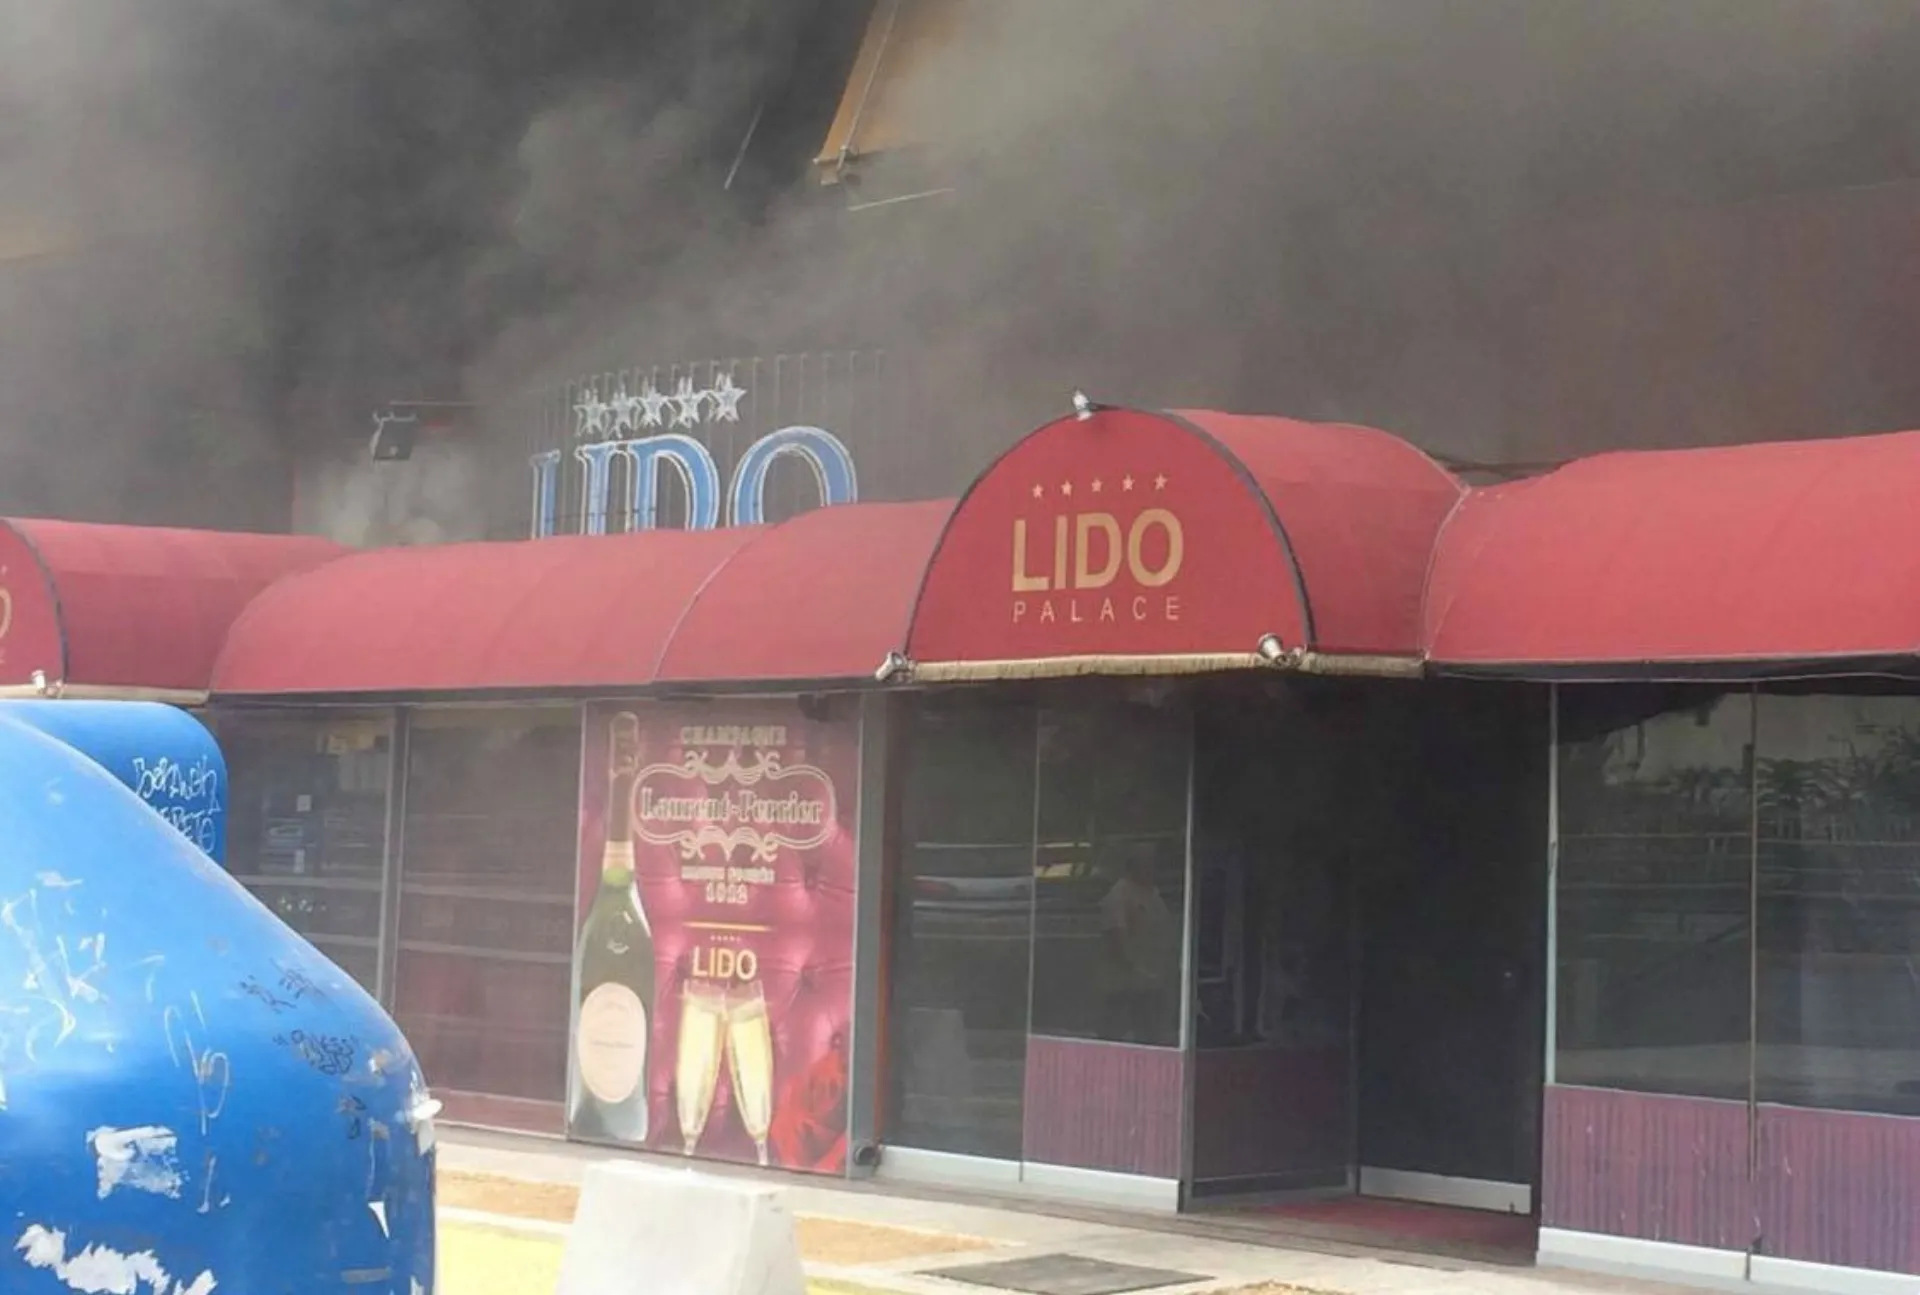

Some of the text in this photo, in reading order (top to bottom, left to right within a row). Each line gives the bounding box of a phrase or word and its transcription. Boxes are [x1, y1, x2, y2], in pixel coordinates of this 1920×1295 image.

[1012, 508, 1184, 592] LIDO
[1013, 596, 1181, 623] PALACE
[691, 946, 757, 981] LIDO
